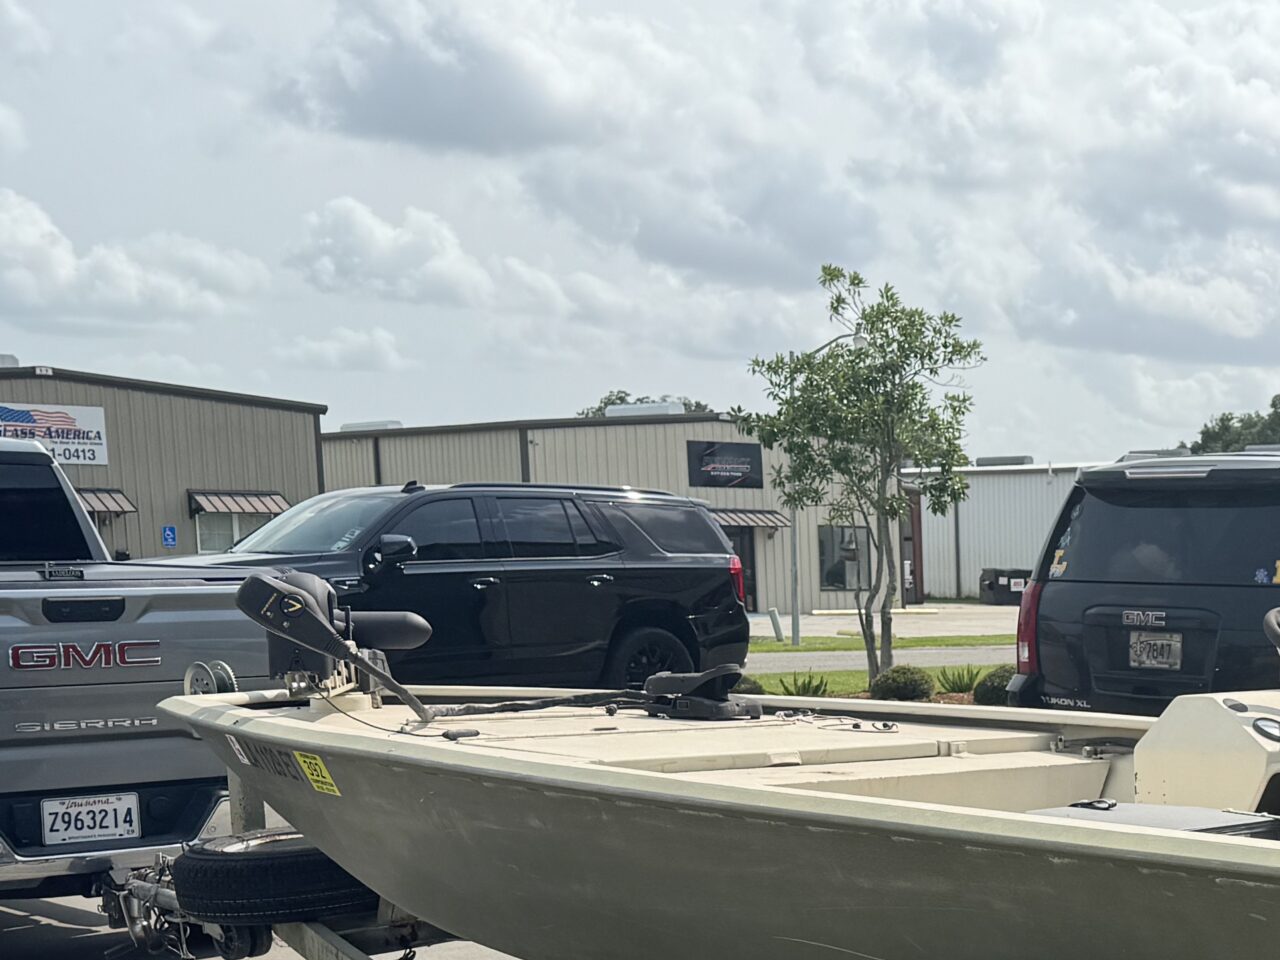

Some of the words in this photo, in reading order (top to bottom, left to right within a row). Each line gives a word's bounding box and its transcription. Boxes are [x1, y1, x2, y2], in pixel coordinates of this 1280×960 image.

[0, 425, 36, 439] LASS
[43, 426, 103, 441] AMERICA
[1122, 610, 1166, 627] GMC
[9, 639, 162, 670] GMC
[1040, 695, 1075, 707] YUKON
[1075, 699, 1092, 708] XL
[15, 716, 158, 732] SIERRA
[48, 807, 134, 833] Z963214
